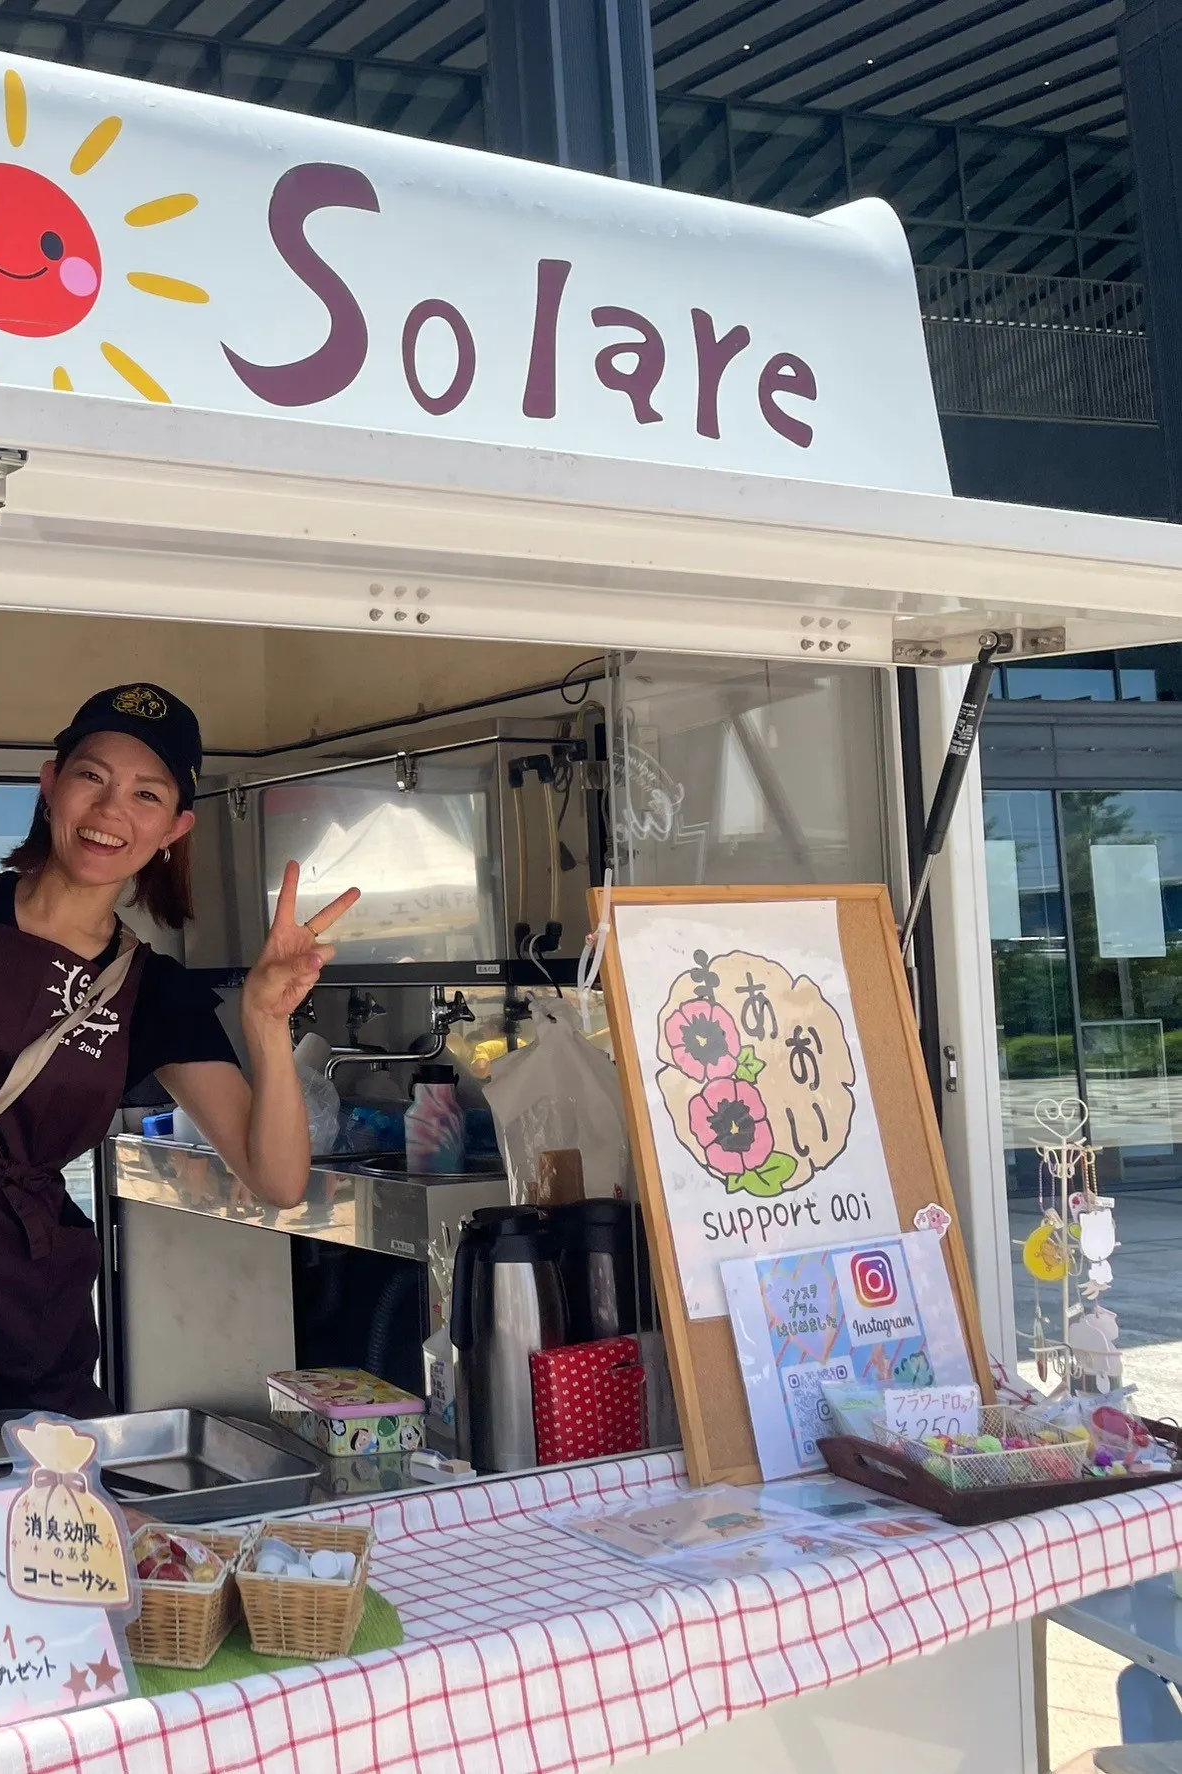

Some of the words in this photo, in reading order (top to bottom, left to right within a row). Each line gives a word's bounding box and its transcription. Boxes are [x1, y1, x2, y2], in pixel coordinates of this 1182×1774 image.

[220, 163, 817, 449] Solare
[78, 1041, 102, 1059] 2008
[702, 1197, 821, 1246] support
[830, 1191, 872, 1221] aoi
[776, 1313, 838, 1337] はじめました
[852, 1314, 915, 1338] Instagram
[893, 1390, 975, 1413] フラワードロップ
[24, 1512, 103, 1546] 消臭効果
[54, 1546, 90, 1562] のある
[23, 1566, 118, 1592] コーヒーサシェ
